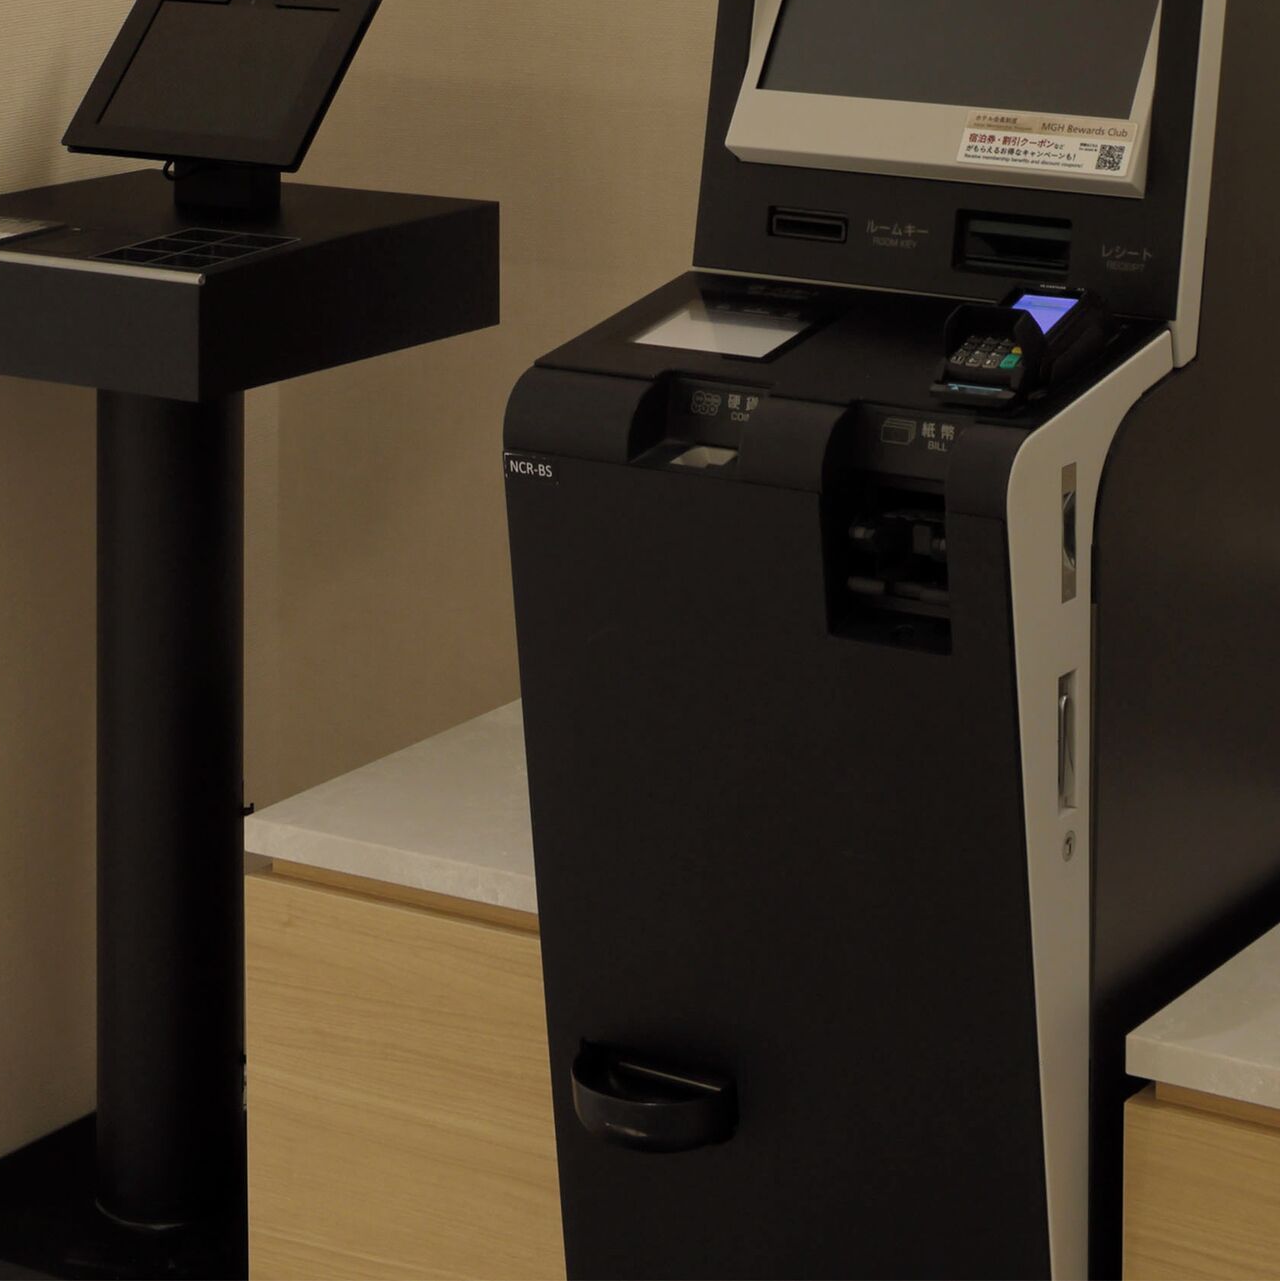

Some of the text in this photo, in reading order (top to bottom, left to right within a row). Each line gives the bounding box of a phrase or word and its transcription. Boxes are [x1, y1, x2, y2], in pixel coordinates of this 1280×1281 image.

[1041, 122, 1065, 133] MGH
[1067, 125, 1106, 137] Rewards
[1108, 127, 1128, 139] Club
[865, 218, 929, 237] ルームキー
[872, 236, 898, 248] ROOM
[1101, 244, 1153, 261] レシート
[927, 440, 948, 452] BILL
[509, 460, 553, 478] NCR-BS
